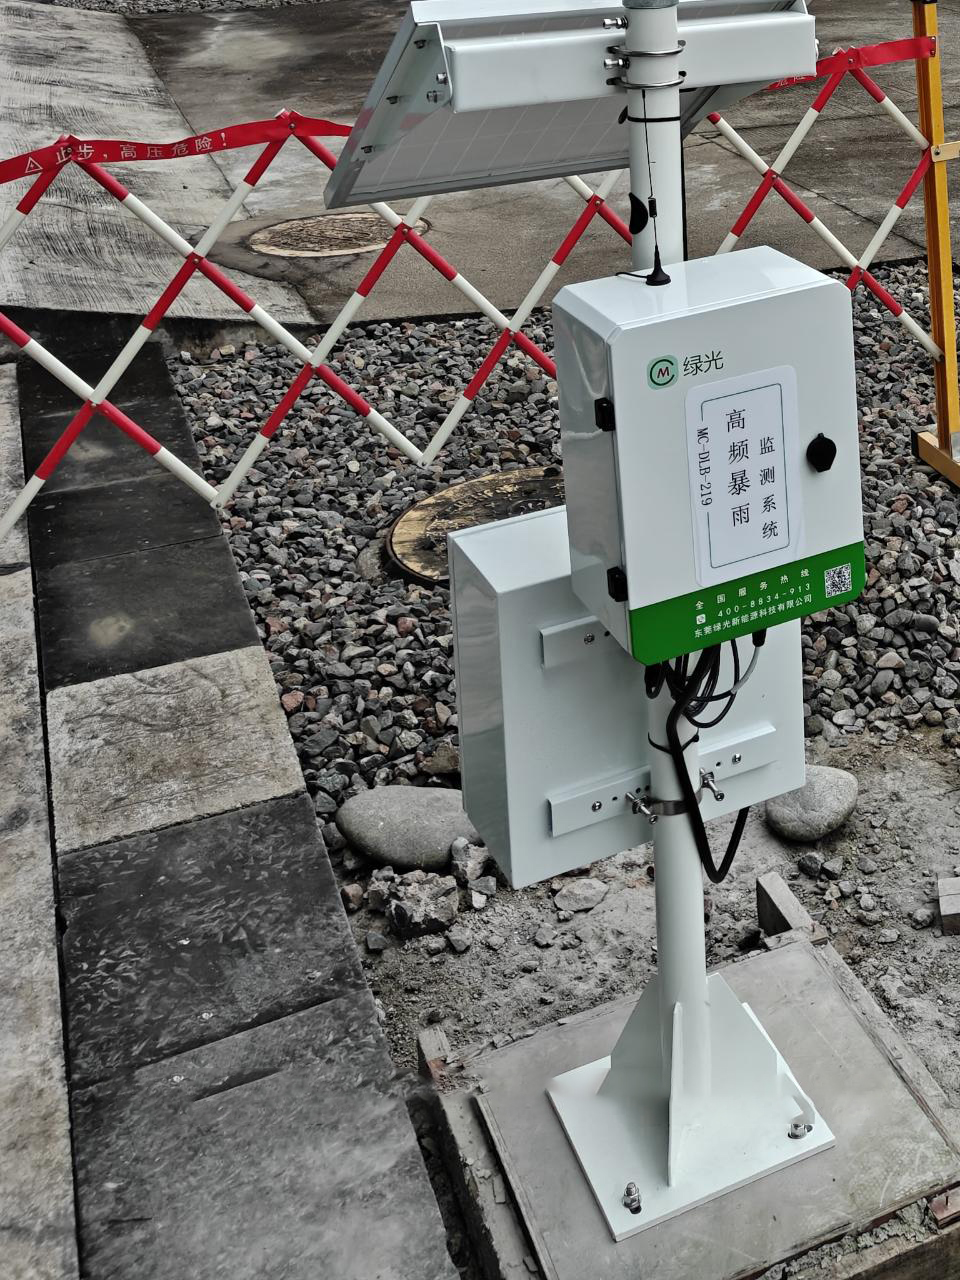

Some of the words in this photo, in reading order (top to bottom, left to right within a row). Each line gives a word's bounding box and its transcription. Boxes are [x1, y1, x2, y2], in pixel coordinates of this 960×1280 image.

[683, 350, 724, 377] 绿光
[697, 426, 713, 507] MC-DLB-219
[725, 408, 752, 527] 高频暴雨
[758, 436, 780, 540] 监测系统
[695, 568, 810, 610] 全国服务热线
[717, 582, 811, 617] 400-8834-913
[694, 593, 812, 638] 东莞绿光新能源科技有限公司
